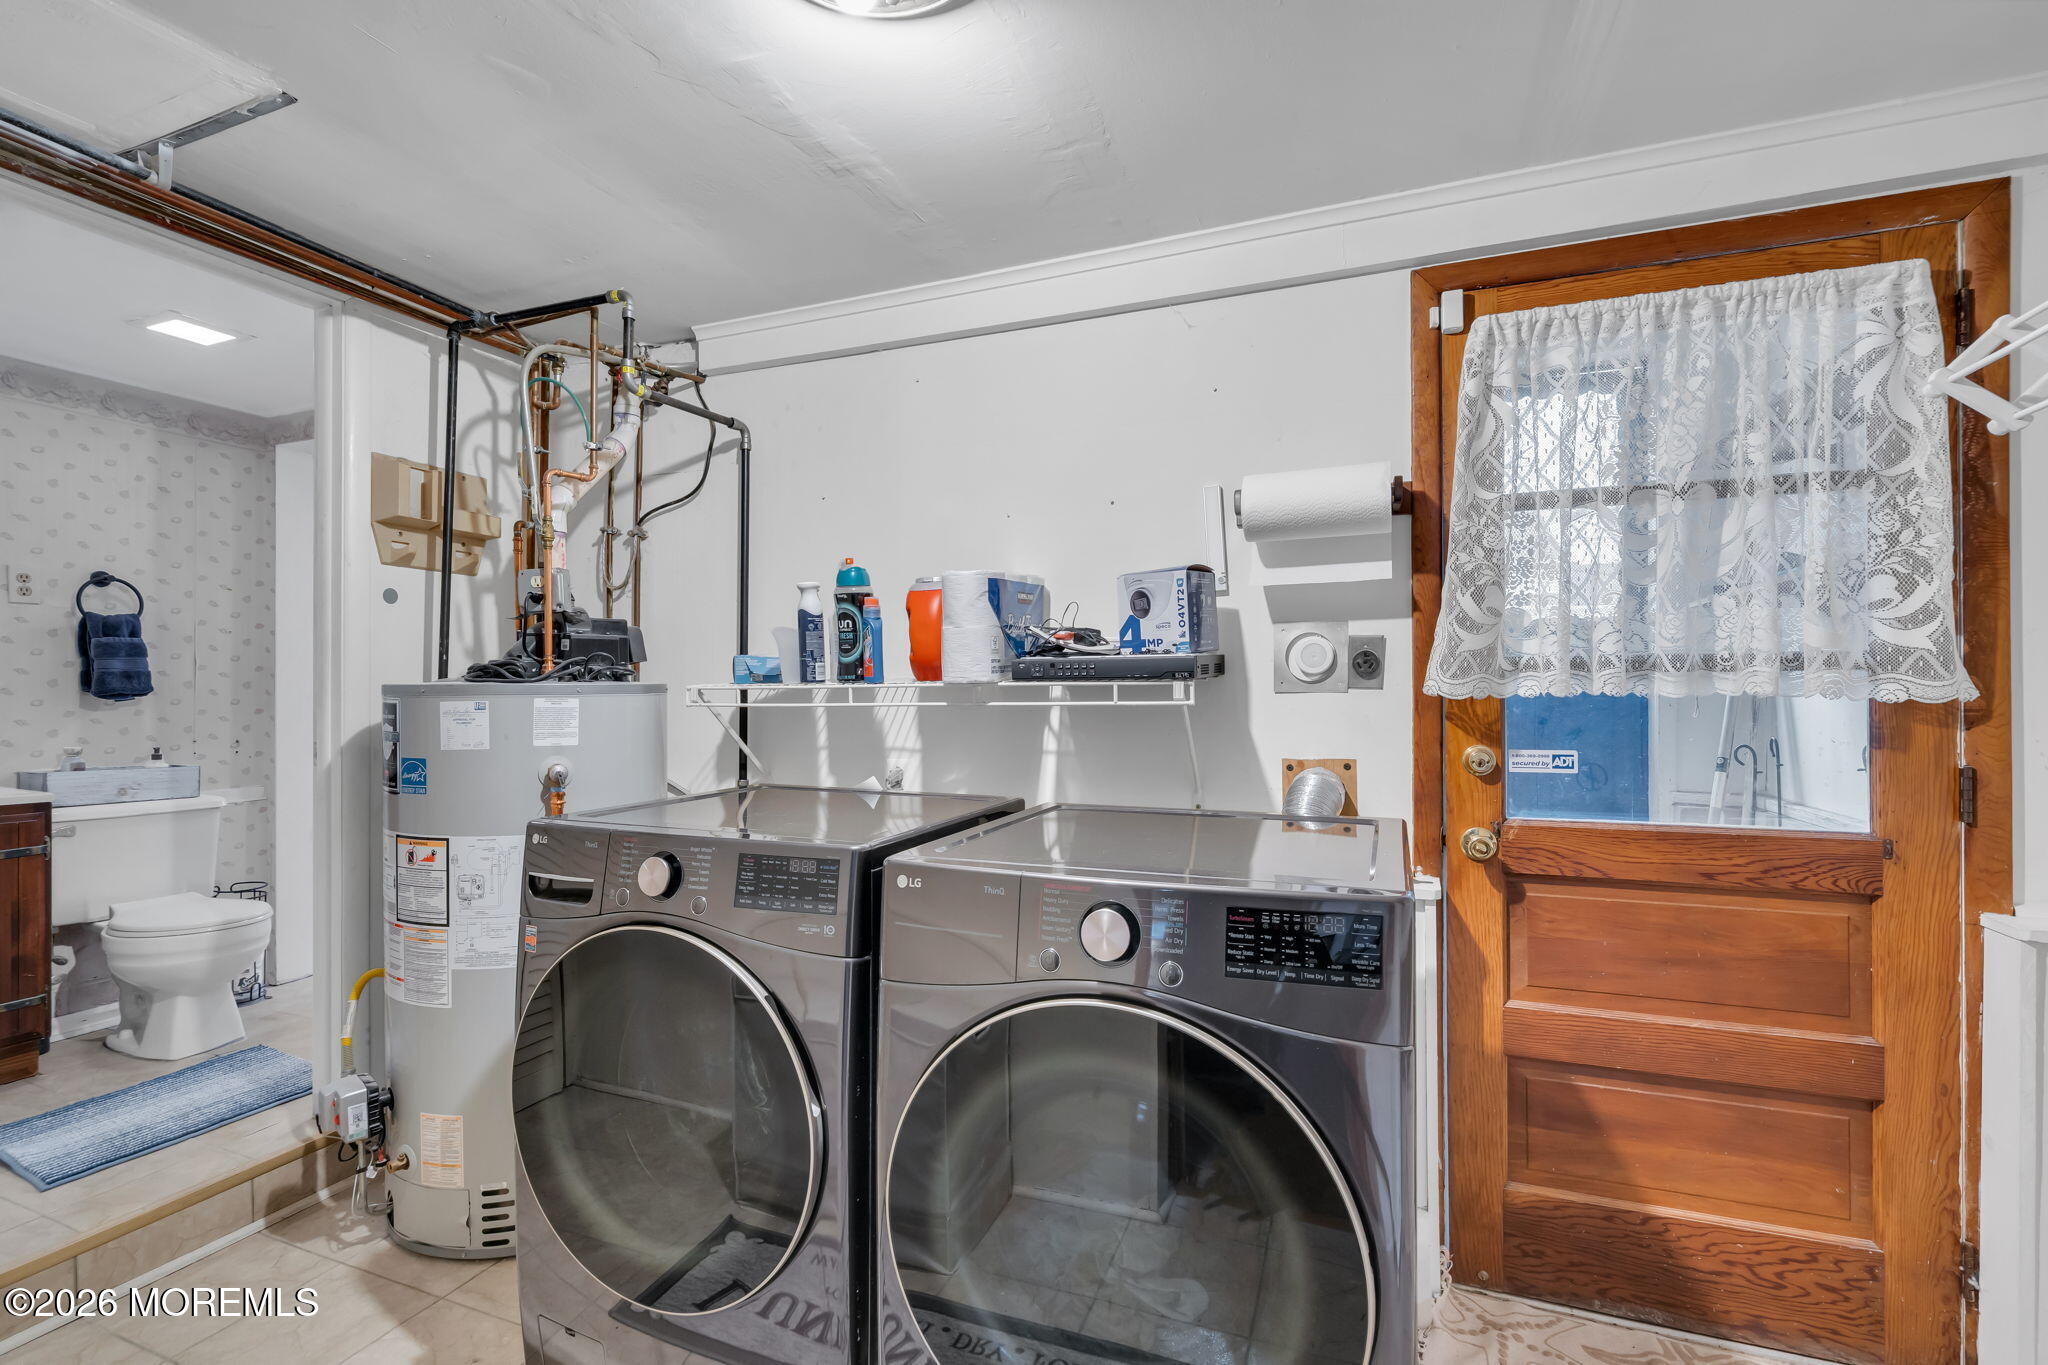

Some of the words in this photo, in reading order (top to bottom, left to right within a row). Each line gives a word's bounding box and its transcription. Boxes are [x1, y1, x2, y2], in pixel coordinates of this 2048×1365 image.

[1147, 638, 1164, 648] MP
[1541, 760, 1551, 768] by
[1552, 756, 1575, 768] ADT
[539, 835, 548, 844] LG
[908, 877, 922, 888] LG
[983, 885, 1005, 896] ThinQ
